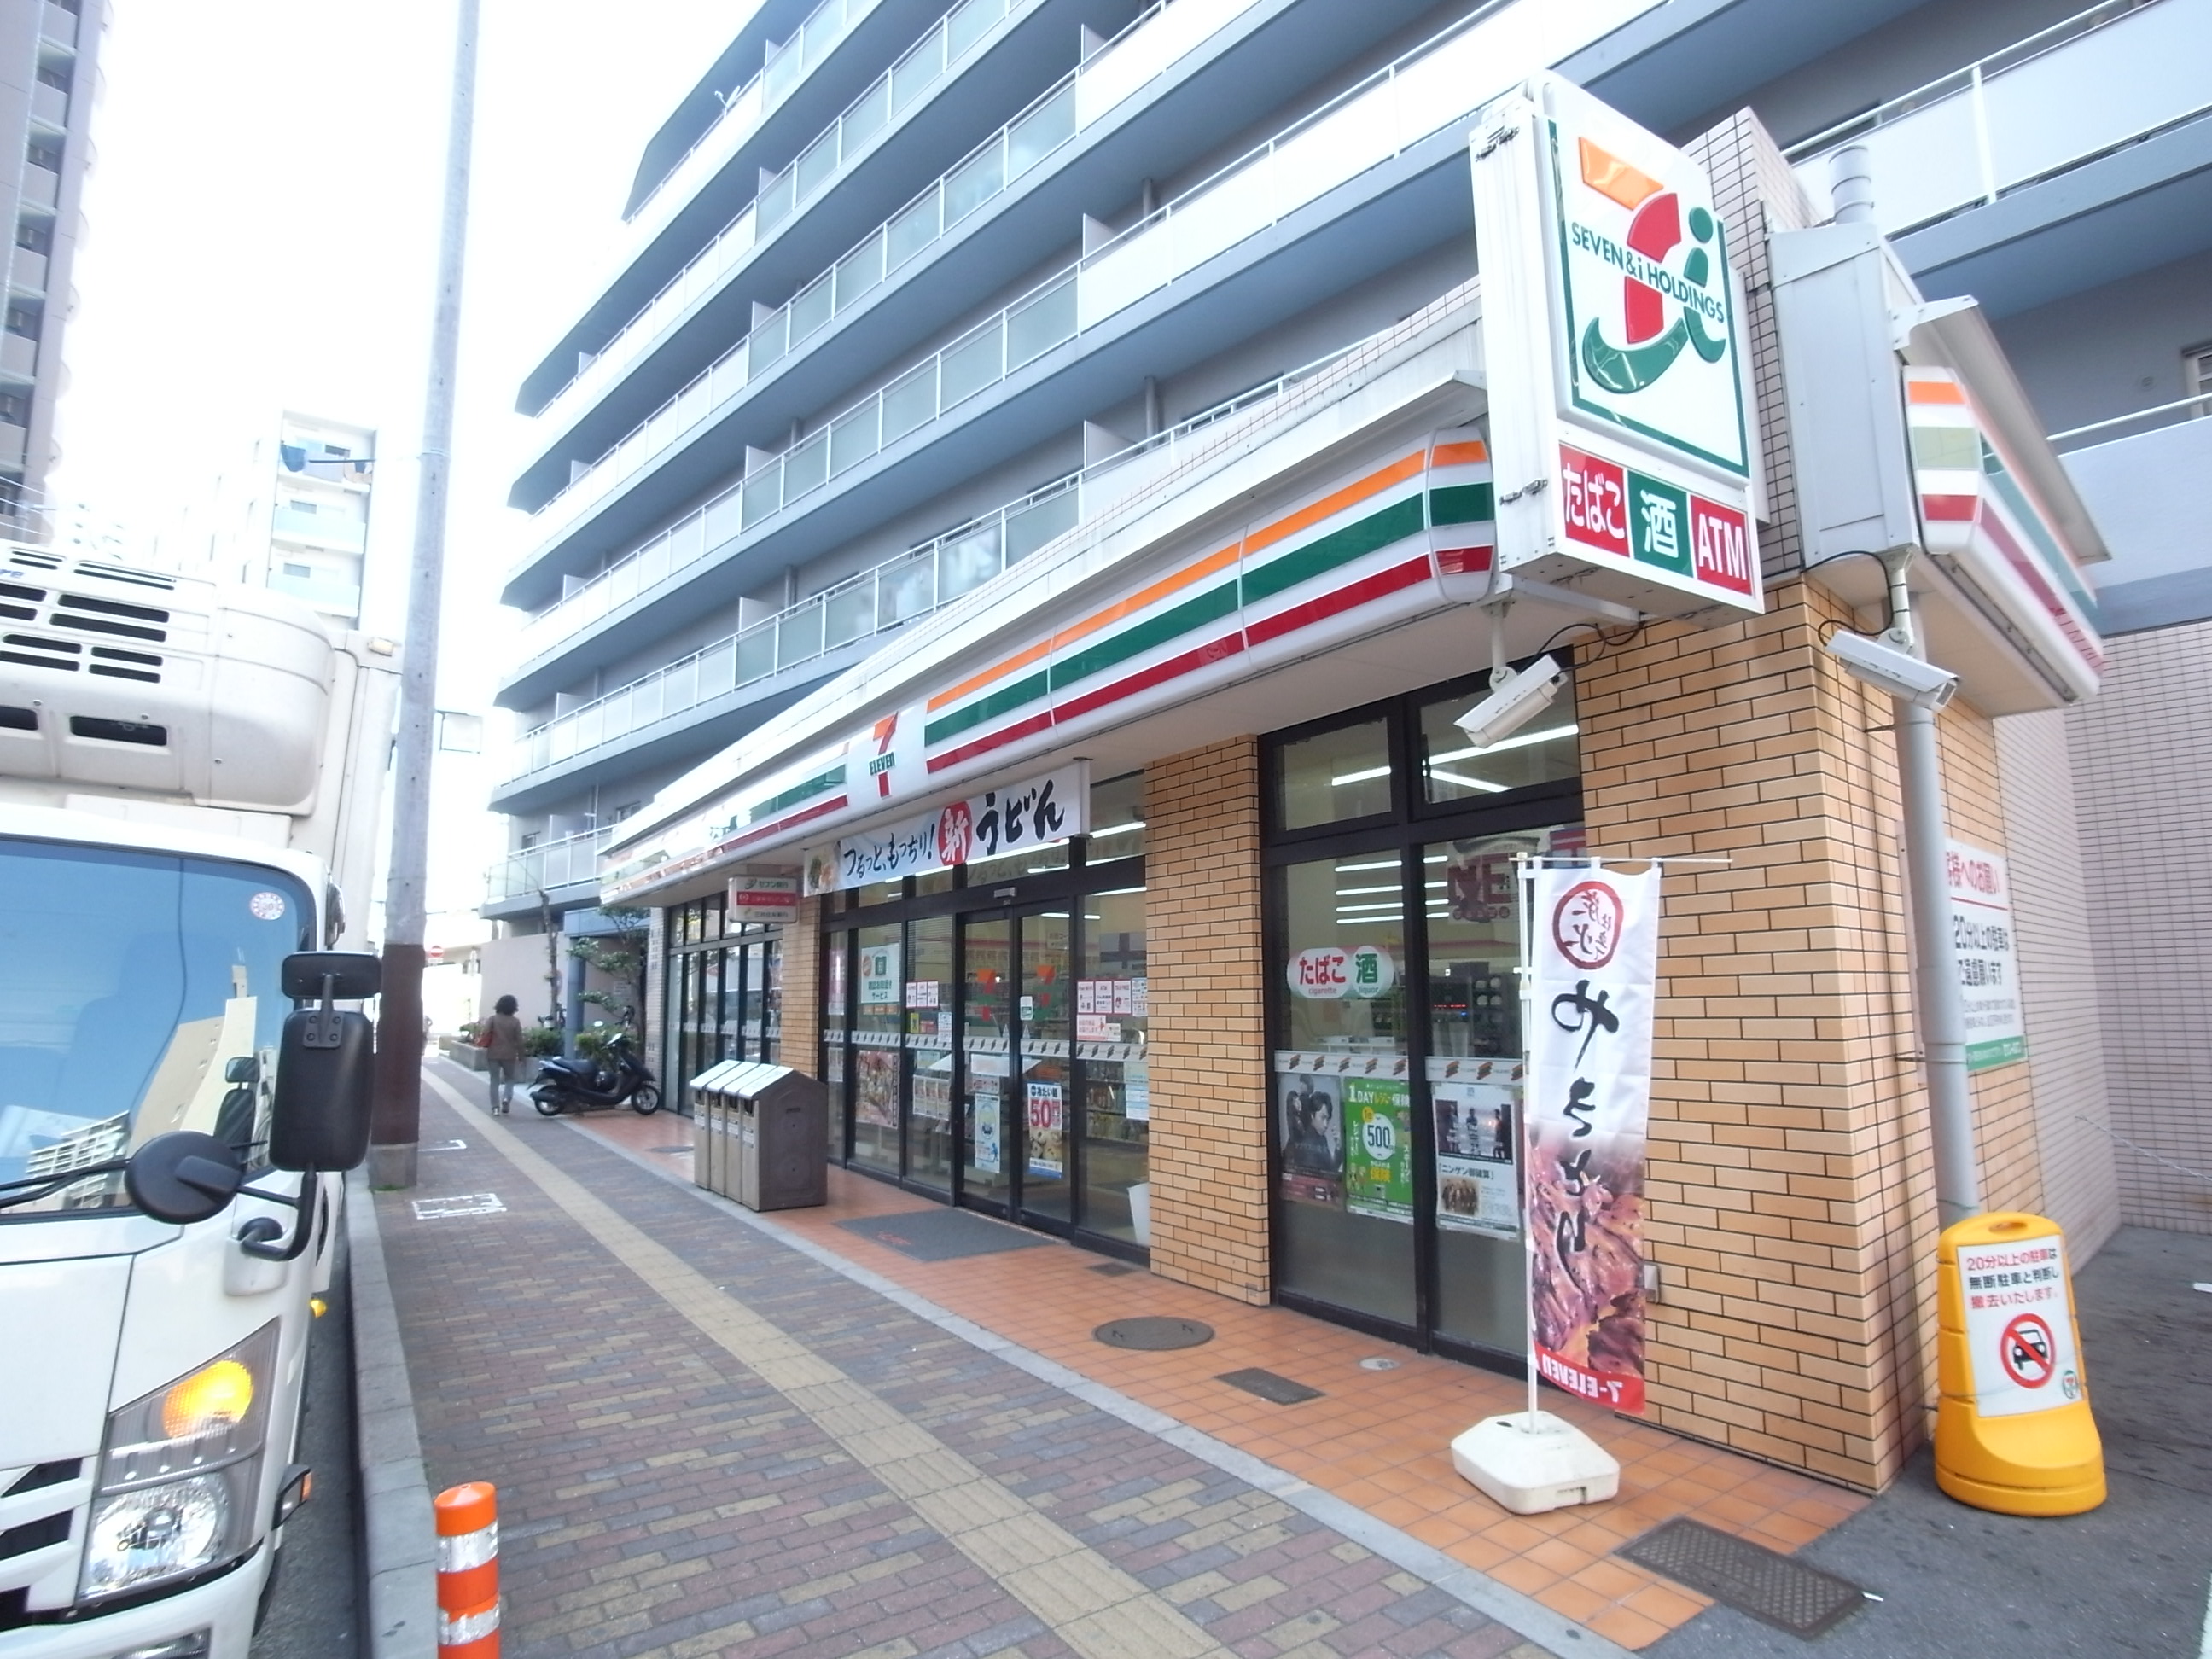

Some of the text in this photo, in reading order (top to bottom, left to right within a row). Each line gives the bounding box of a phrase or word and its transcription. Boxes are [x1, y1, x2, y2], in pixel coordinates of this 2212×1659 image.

[1647, 268, 1726, 324] HOLDINGS
[1563, 462, 1626, 540] たばこ
[1640, 489, 1679, 560] 酒
[1697, 510, 1749, 582] ATM
[941, 807, 969, 864] 新
[975, 778, 1066, 857] うどん
[1299, 954, 1346, 986] たばこ
[1308, 987, 1337, 996] cigarette
[1355, 953, 1377, 984] 酒
[1966, 1248, 2058, 1272] 20分以上の駐車は
[1970, 1266, 2059, 1290] 無断駐車と判断し
